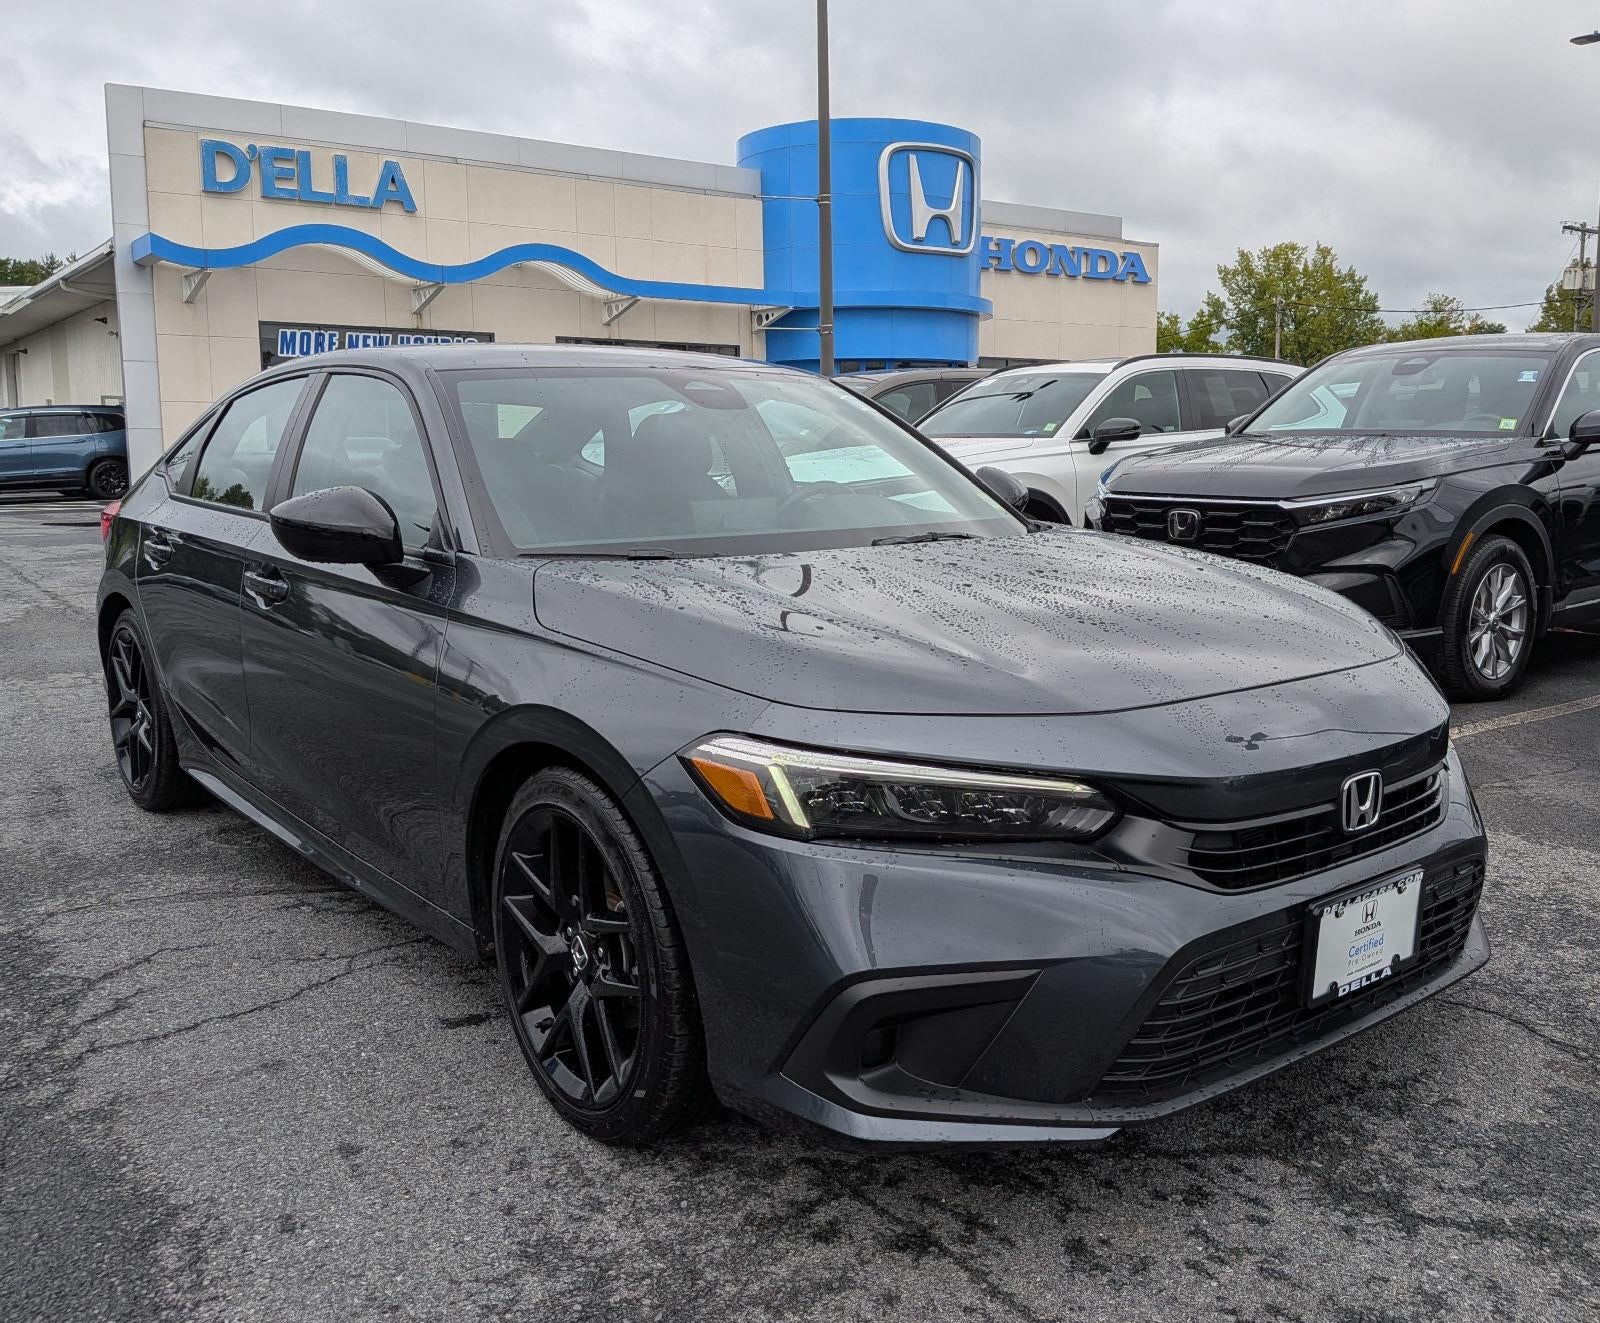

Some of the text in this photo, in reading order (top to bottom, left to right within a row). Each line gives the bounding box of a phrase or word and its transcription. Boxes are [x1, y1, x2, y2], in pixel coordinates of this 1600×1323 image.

[200, 138, 417, 214] D'ELLA
[981, 236, 1152, 283] HONDA
[278, 329, 339, 357] MORE
[1354, 920, 1382, 937] HONDA
[1348, 934, 1384, 958] Certified
[1338, 966, 1392, 998] DELLA
